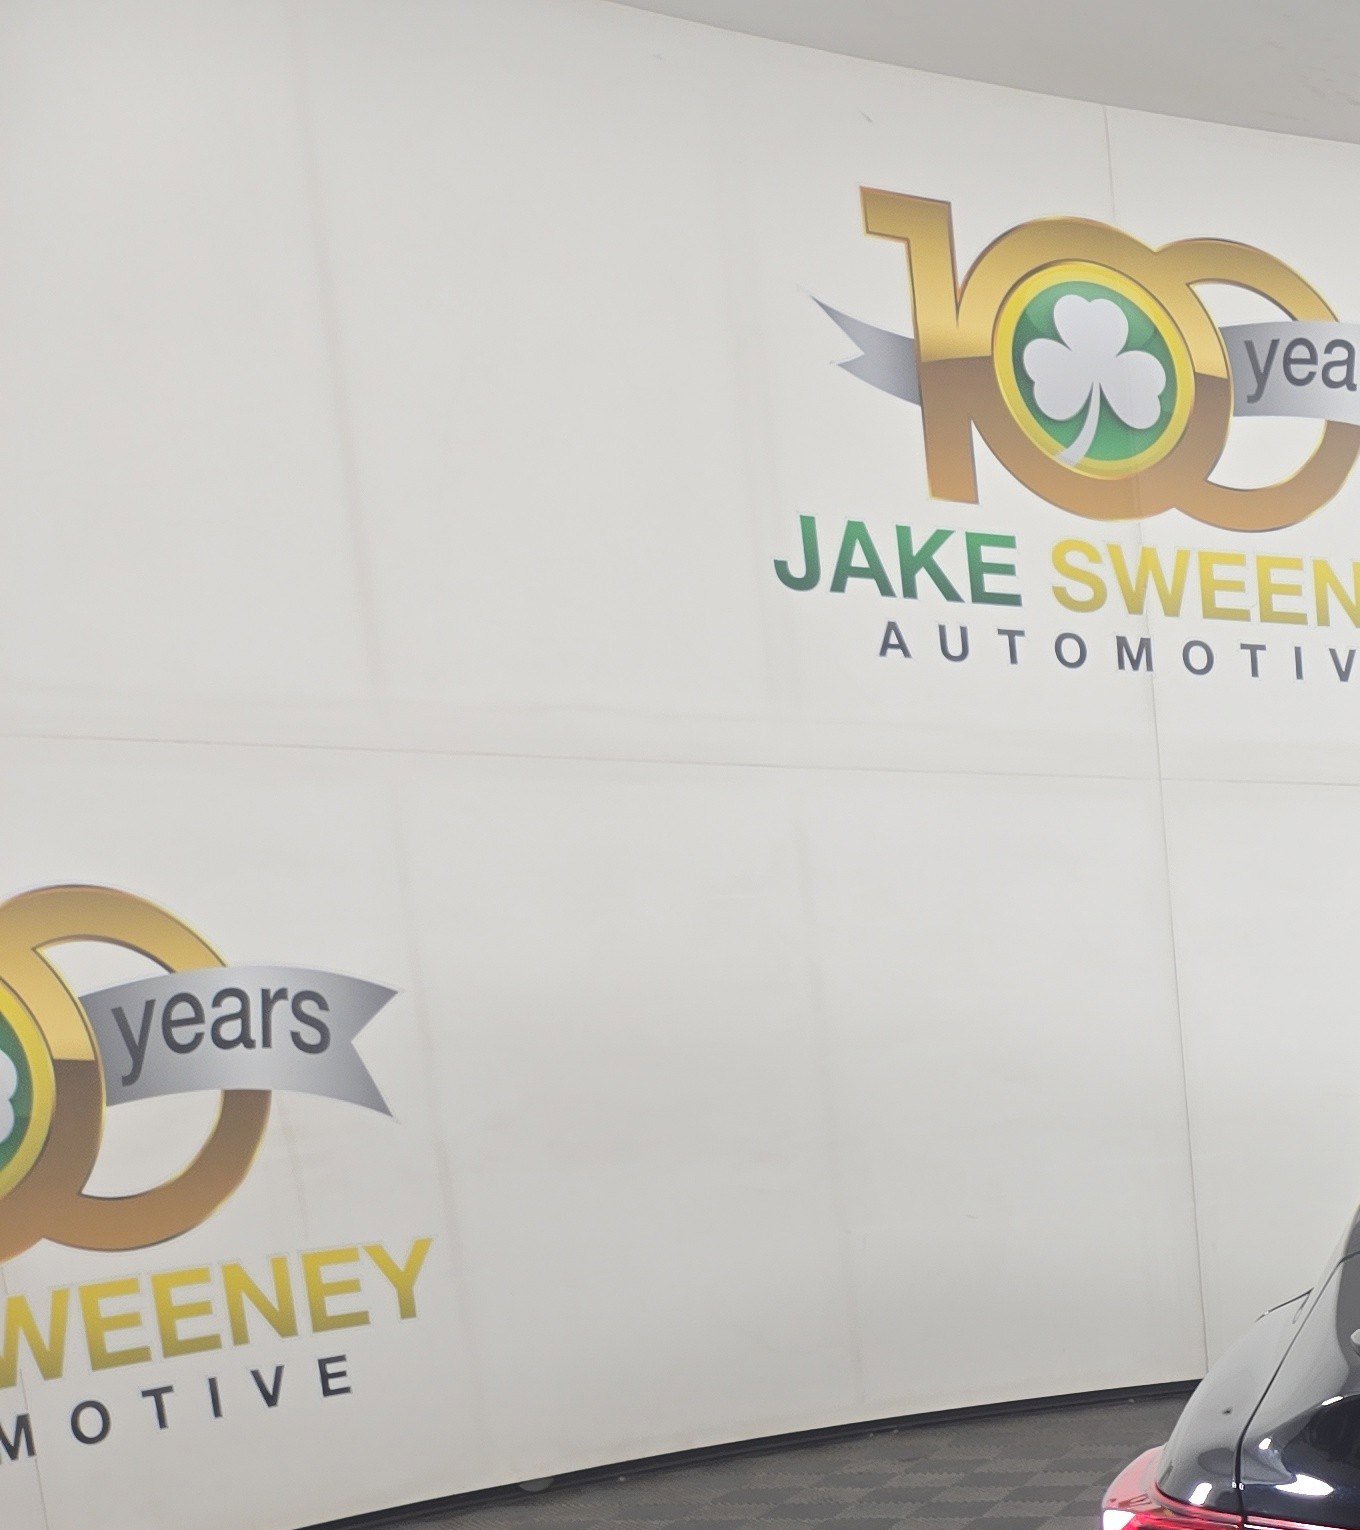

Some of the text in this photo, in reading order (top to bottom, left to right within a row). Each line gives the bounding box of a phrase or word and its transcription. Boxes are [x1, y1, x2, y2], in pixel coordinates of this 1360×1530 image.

[774, 515, 1022, 606] JAKE
[111, 987, 331, 1087] years
[0, 1238, 433, 1390] WEENEY
[0, 1355, 352, 1461] MOTIVE
